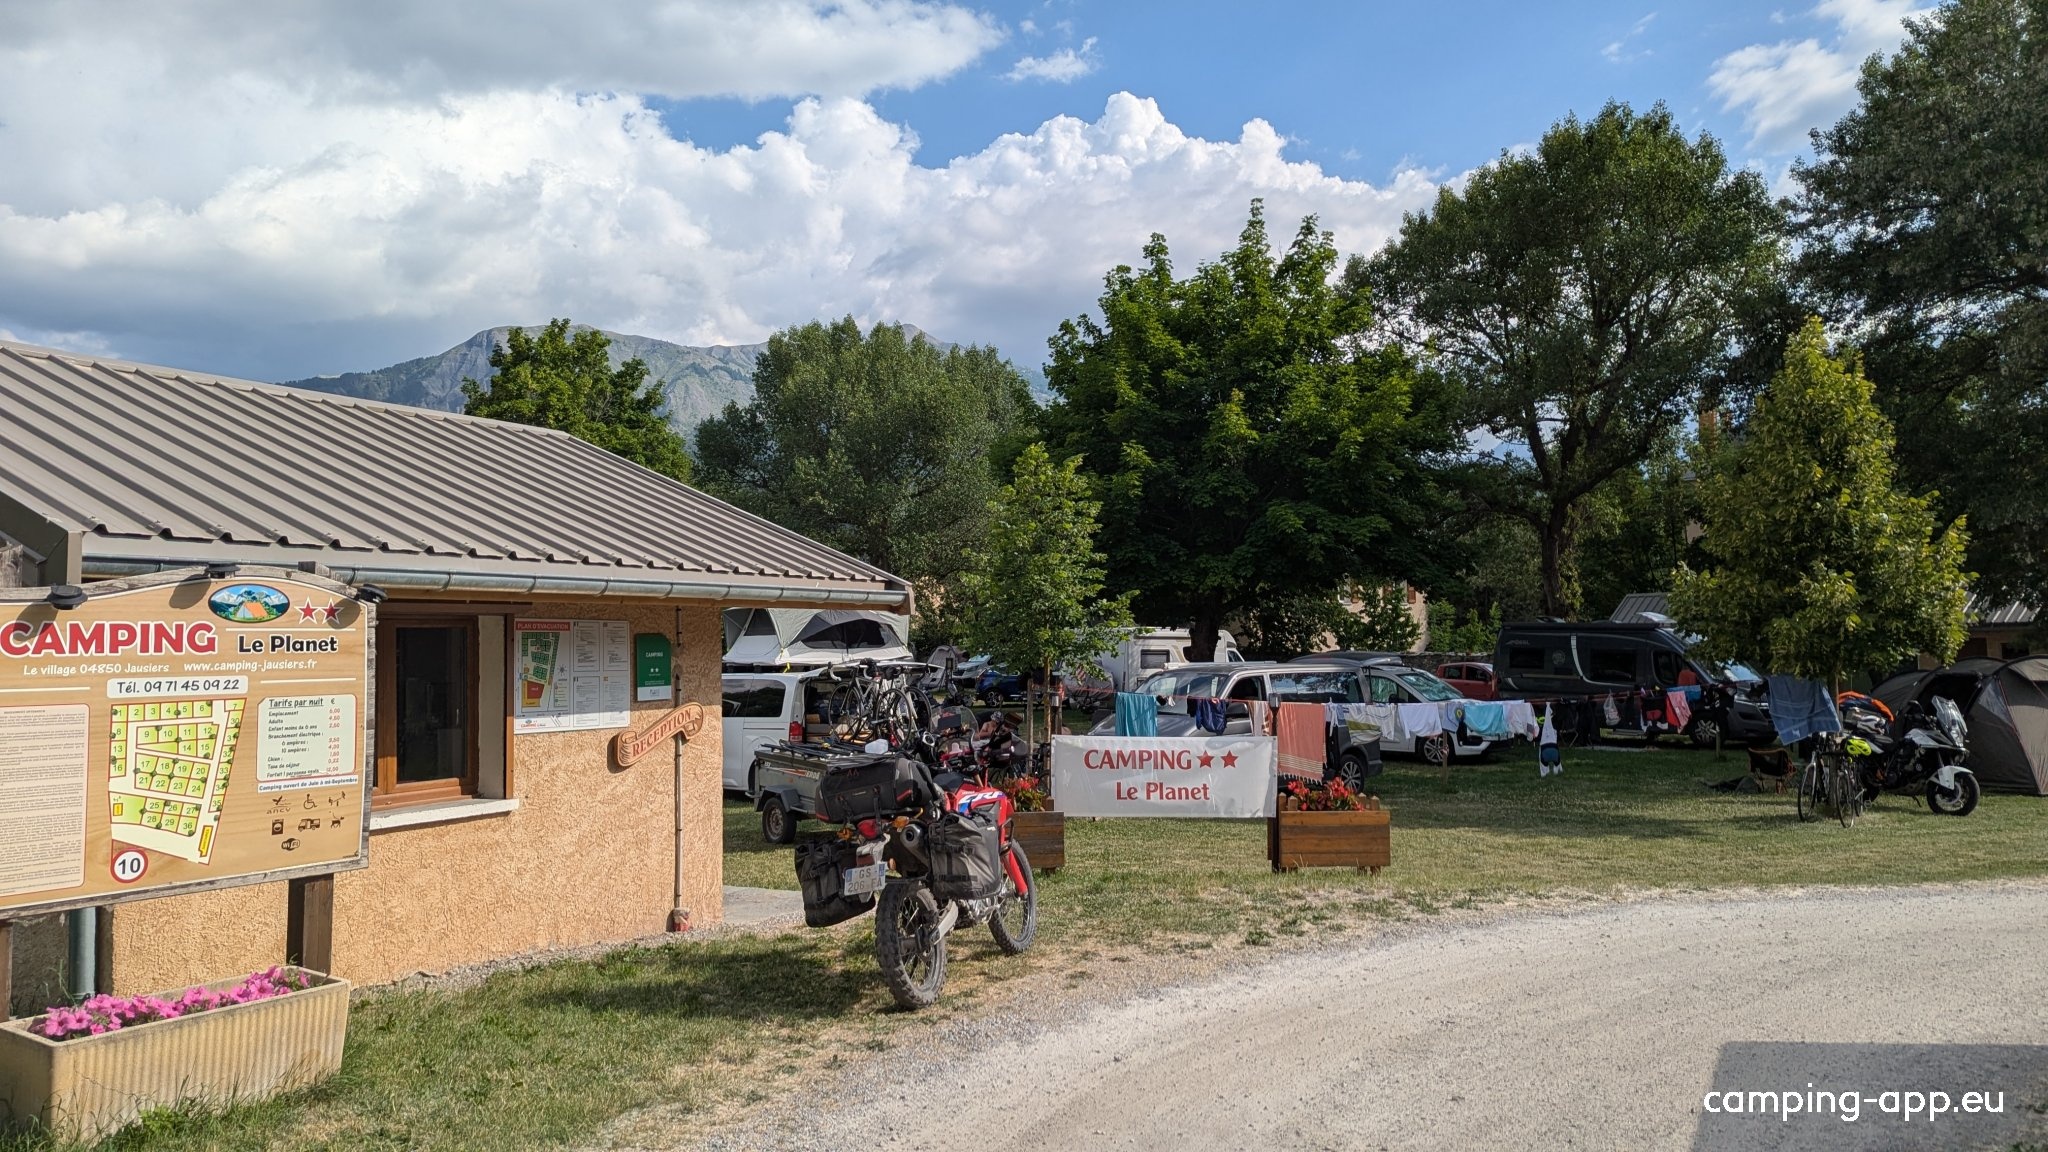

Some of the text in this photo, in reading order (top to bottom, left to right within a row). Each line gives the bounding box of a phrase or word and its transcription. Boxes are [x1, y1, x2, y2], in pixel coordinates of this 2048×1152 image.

[0, 622, 217, 656] CAMPING
[238, 635, 338, 653] Le Planet
[23, 662, 170, 677] Le village 04850 Jausiers
[184, 658, 317, 672] www.camping-jausiers.fr
[117, 679, 239, 694] Tél. 09 71 45 09 22
[269, 699, 292, 708] Tarifs
[294, 699, 307, 708] par
[309, 698, 323, 706] nuit
[631, 707, 692, 757] RECEPTION
[1084, 749, 1192, 770] CAMPING
[259, 783, 281, 791] Camping
[1116, 781, 1210, 800] Le Planet
[118, 857, 141, 874] 10
[859, 868, 871, 878] GS
[848, 878, 882, 893] 206 FA
